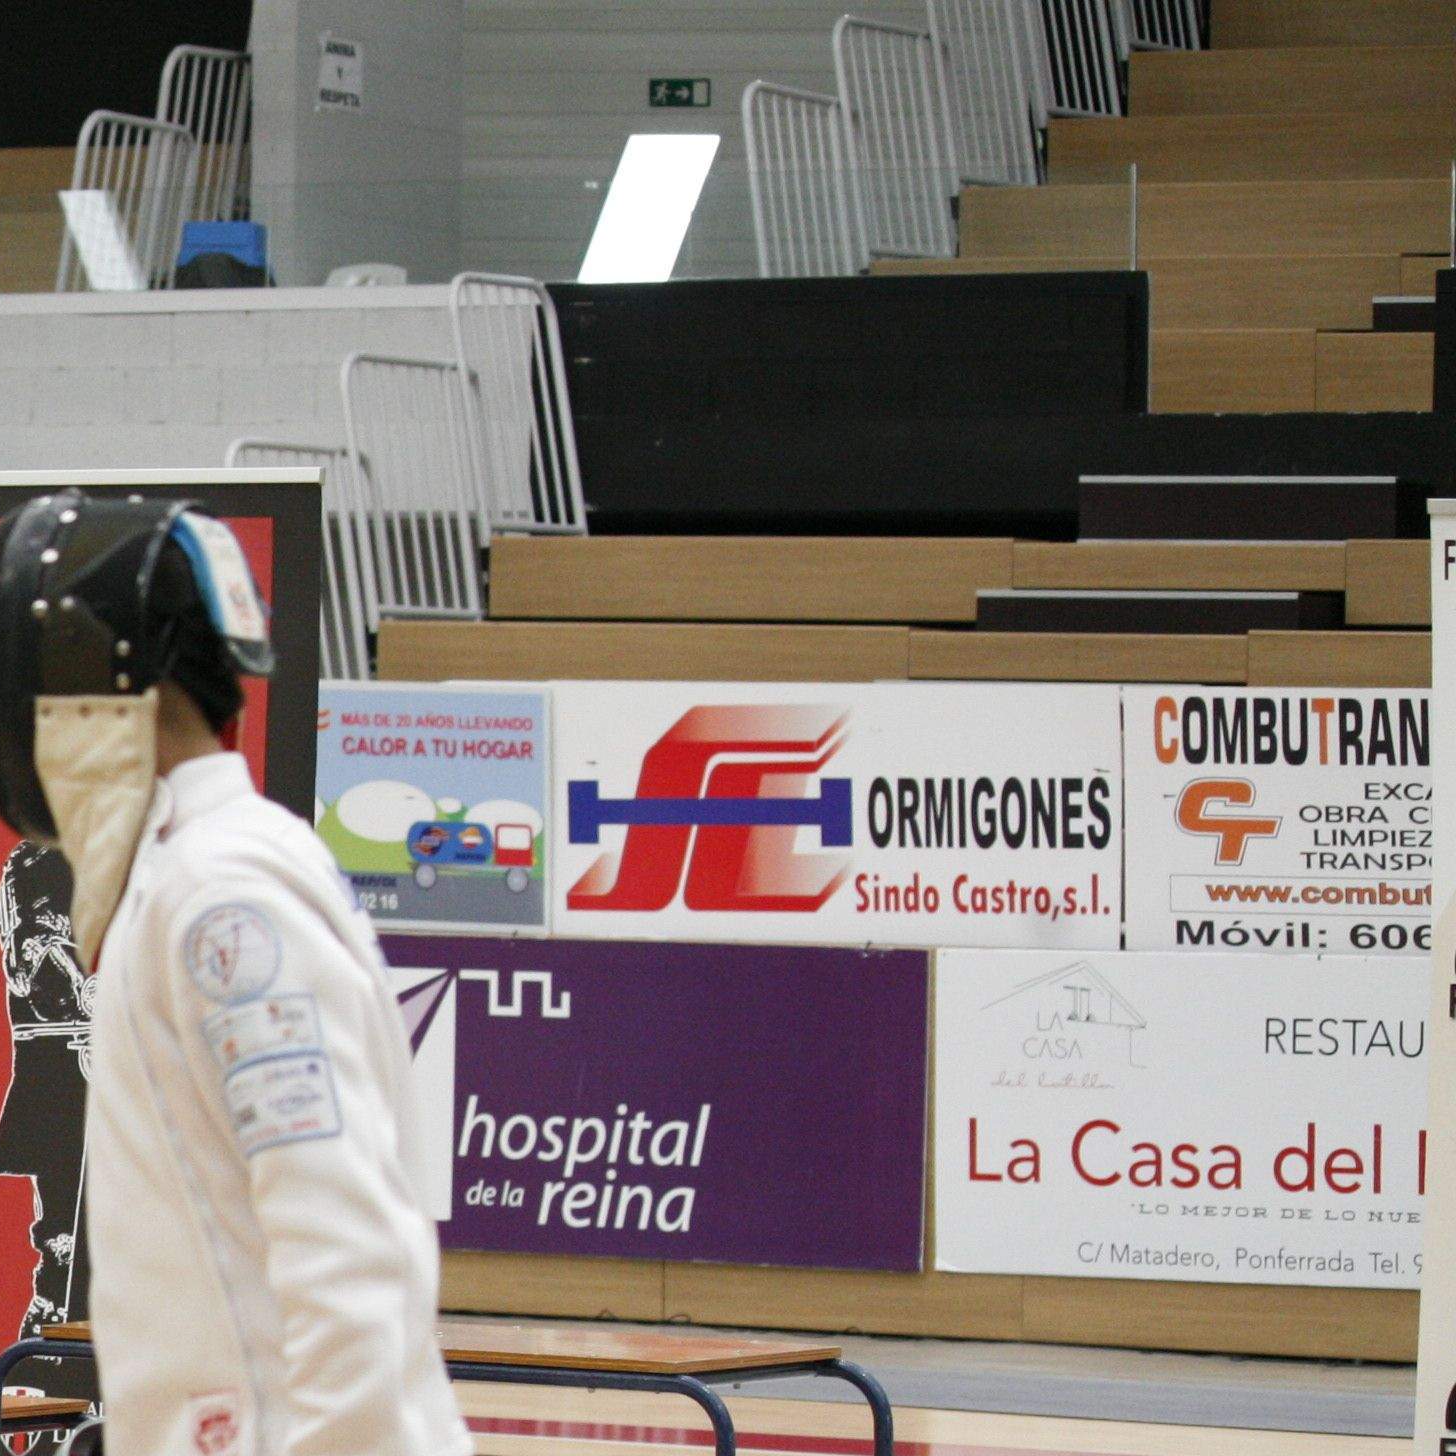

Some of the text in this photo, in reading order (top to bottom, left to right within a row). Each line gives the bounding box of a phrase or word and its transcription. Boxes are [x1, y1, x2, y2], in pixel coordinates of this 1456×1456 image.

[396, 715, 412, 728] 20
[416, 713, 455, 729] AÑOS
[458, 716, 534, 732] LLEVANDO
[341, 735, 535, 760] CALOR A TU HOGAR
[1298, 805, 1389, 824] OBRA
[1313, 829, 1432, 849] LIMPIEZ
[1299, 851, 1432, 872] TRANSP
[854, 872, 939, 915] Sindo
[1175, 919, 1328, 949] Móvil:
[1264, 1017, 1426, 1059] RESTAU
[456, 1094, 712, 1179] hospital
[968, 1116, 1041, 1184] La
[1070, 1118, 1243, 1191] Casa
[1272, 1121, 1383, 1195] del
[464, 1168, 696, 1233] de la reina
[1180, 1204, 1269, 1219] MEJOR
[1280, 1207, 1313, 1221] DE
[1324, 1209, 1357, 1223] LO
[1367, 1210, 1421, 1224] NUE
[1109, 1242, 1221, 1271] Matadero,
[1234, 1247, 1355, 1273] Ponferrada
[1368, 1251, 1406, 1275] Tel.
